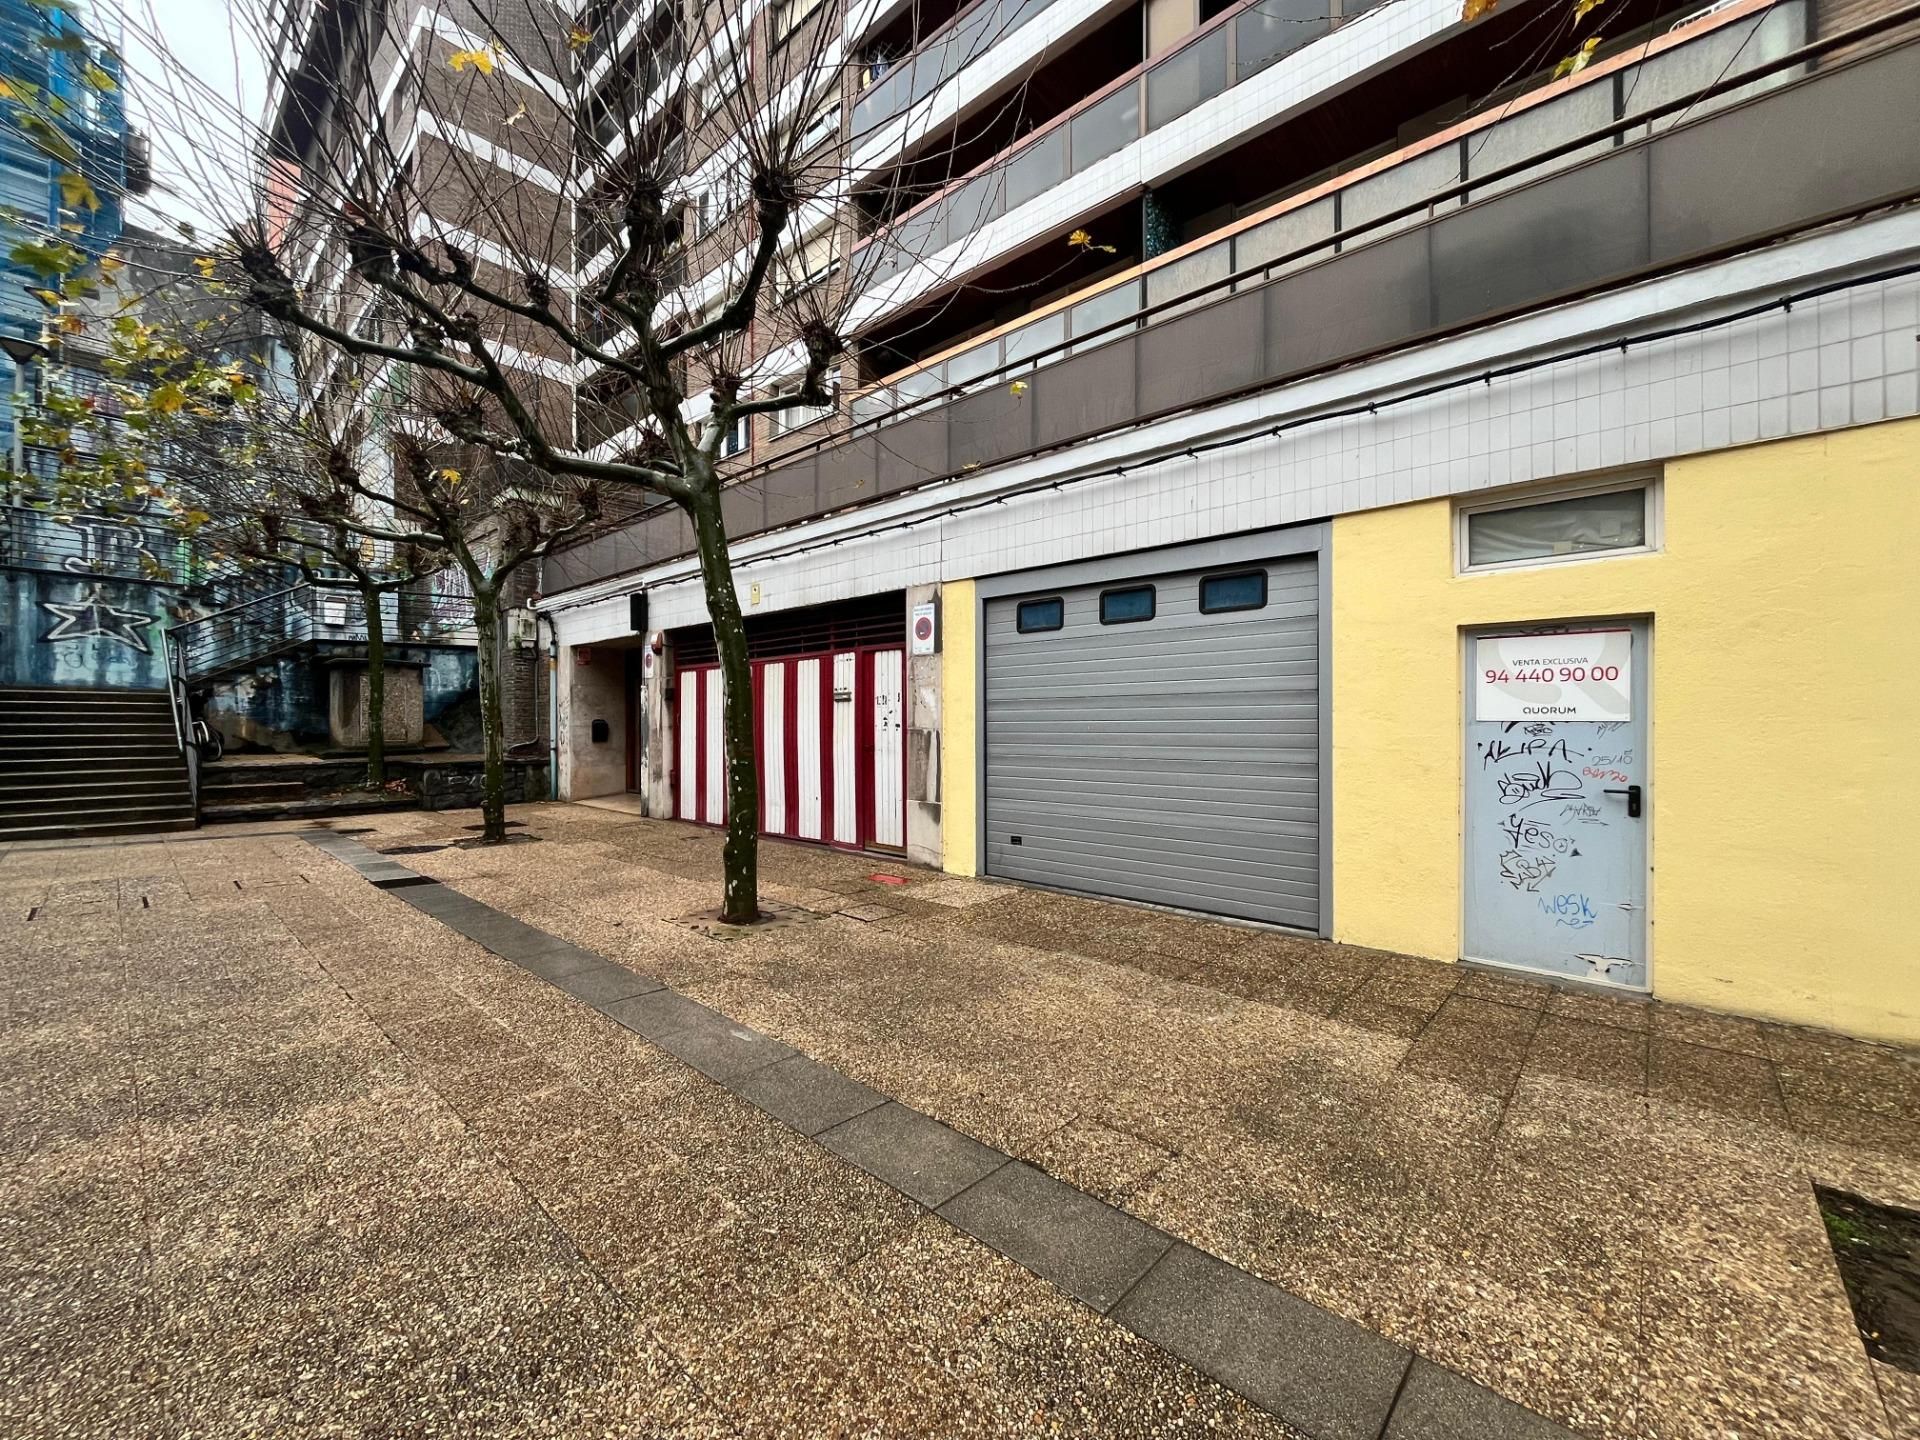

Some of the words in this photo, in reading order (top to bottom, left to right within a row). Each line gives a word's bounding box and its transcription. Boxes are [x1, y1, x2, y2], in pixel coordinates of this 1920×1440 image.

[1543, 657, 1588, 665] EXCLUSIVA
[1485, 669, 1509, 683] 94
[1515, 668, 1554, 683] 440
[1559, 667, 1585, 682] 90
[1591, 666, 1619, 681] 00
[1523, 706, 1576, 714] QUORUM
